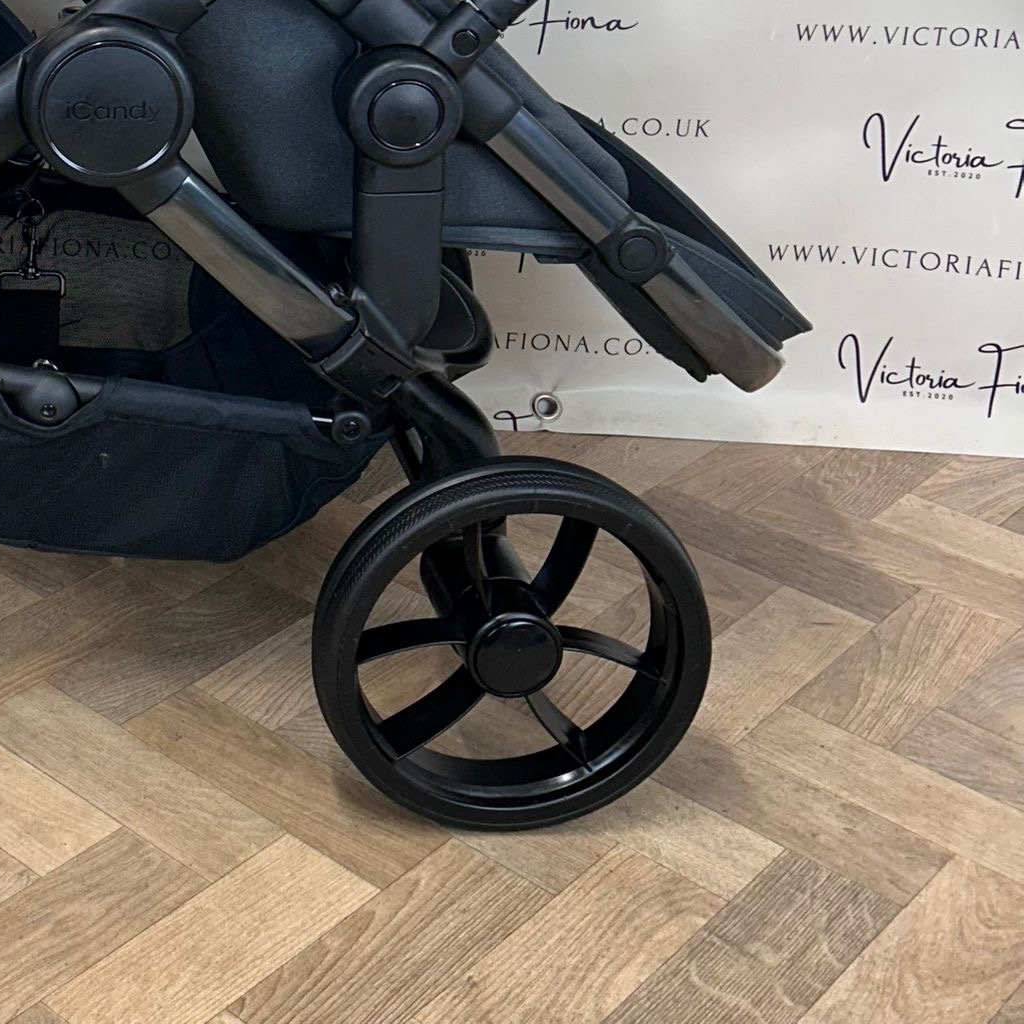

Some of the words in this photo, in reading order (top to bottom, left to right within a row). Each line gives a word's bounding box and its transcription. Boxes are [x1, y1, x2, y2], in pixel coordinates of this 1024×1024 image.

[65, 101, 160, 124] iCandy
[863, 113, 1004, 182] Victoria
[928, 169, 981, 179] EST.2020
[838, 333, 976, 404] Victoria
[903, 391, 954, 400] EST.2020
